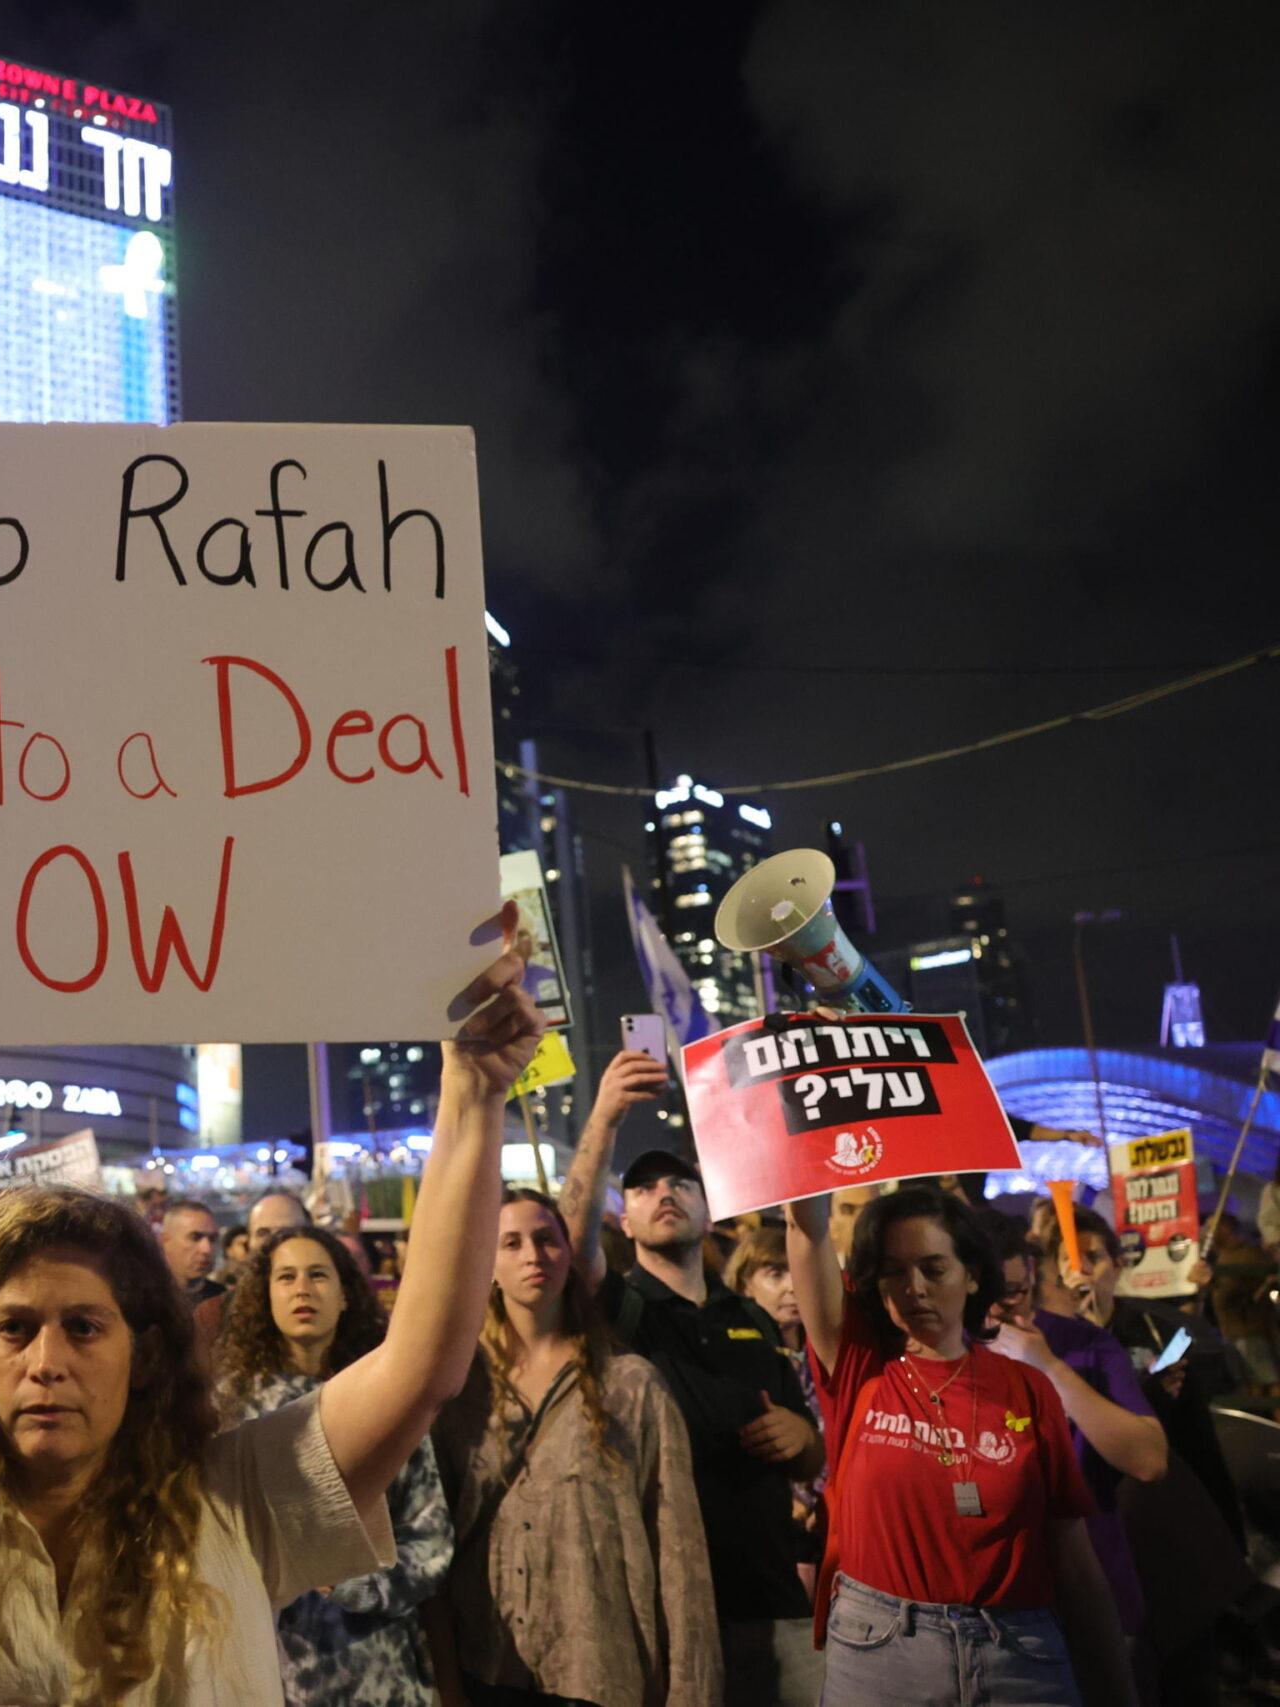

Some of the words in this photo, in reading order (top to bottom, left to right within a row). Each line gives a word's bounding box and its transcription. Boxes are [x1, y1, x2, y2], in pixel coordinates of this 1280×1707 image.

[83, 85, 158, 124] PLAZA
[81, 126, 172, 222] יחד
[115, 453, 446, 600] Rafah
[117, 731, 179, 800] a
[200, 645, 472, 799] Deal
[743, 1026, 932, 1078] ויתרתם
[794, 1068, 926, 1121] עלי?
